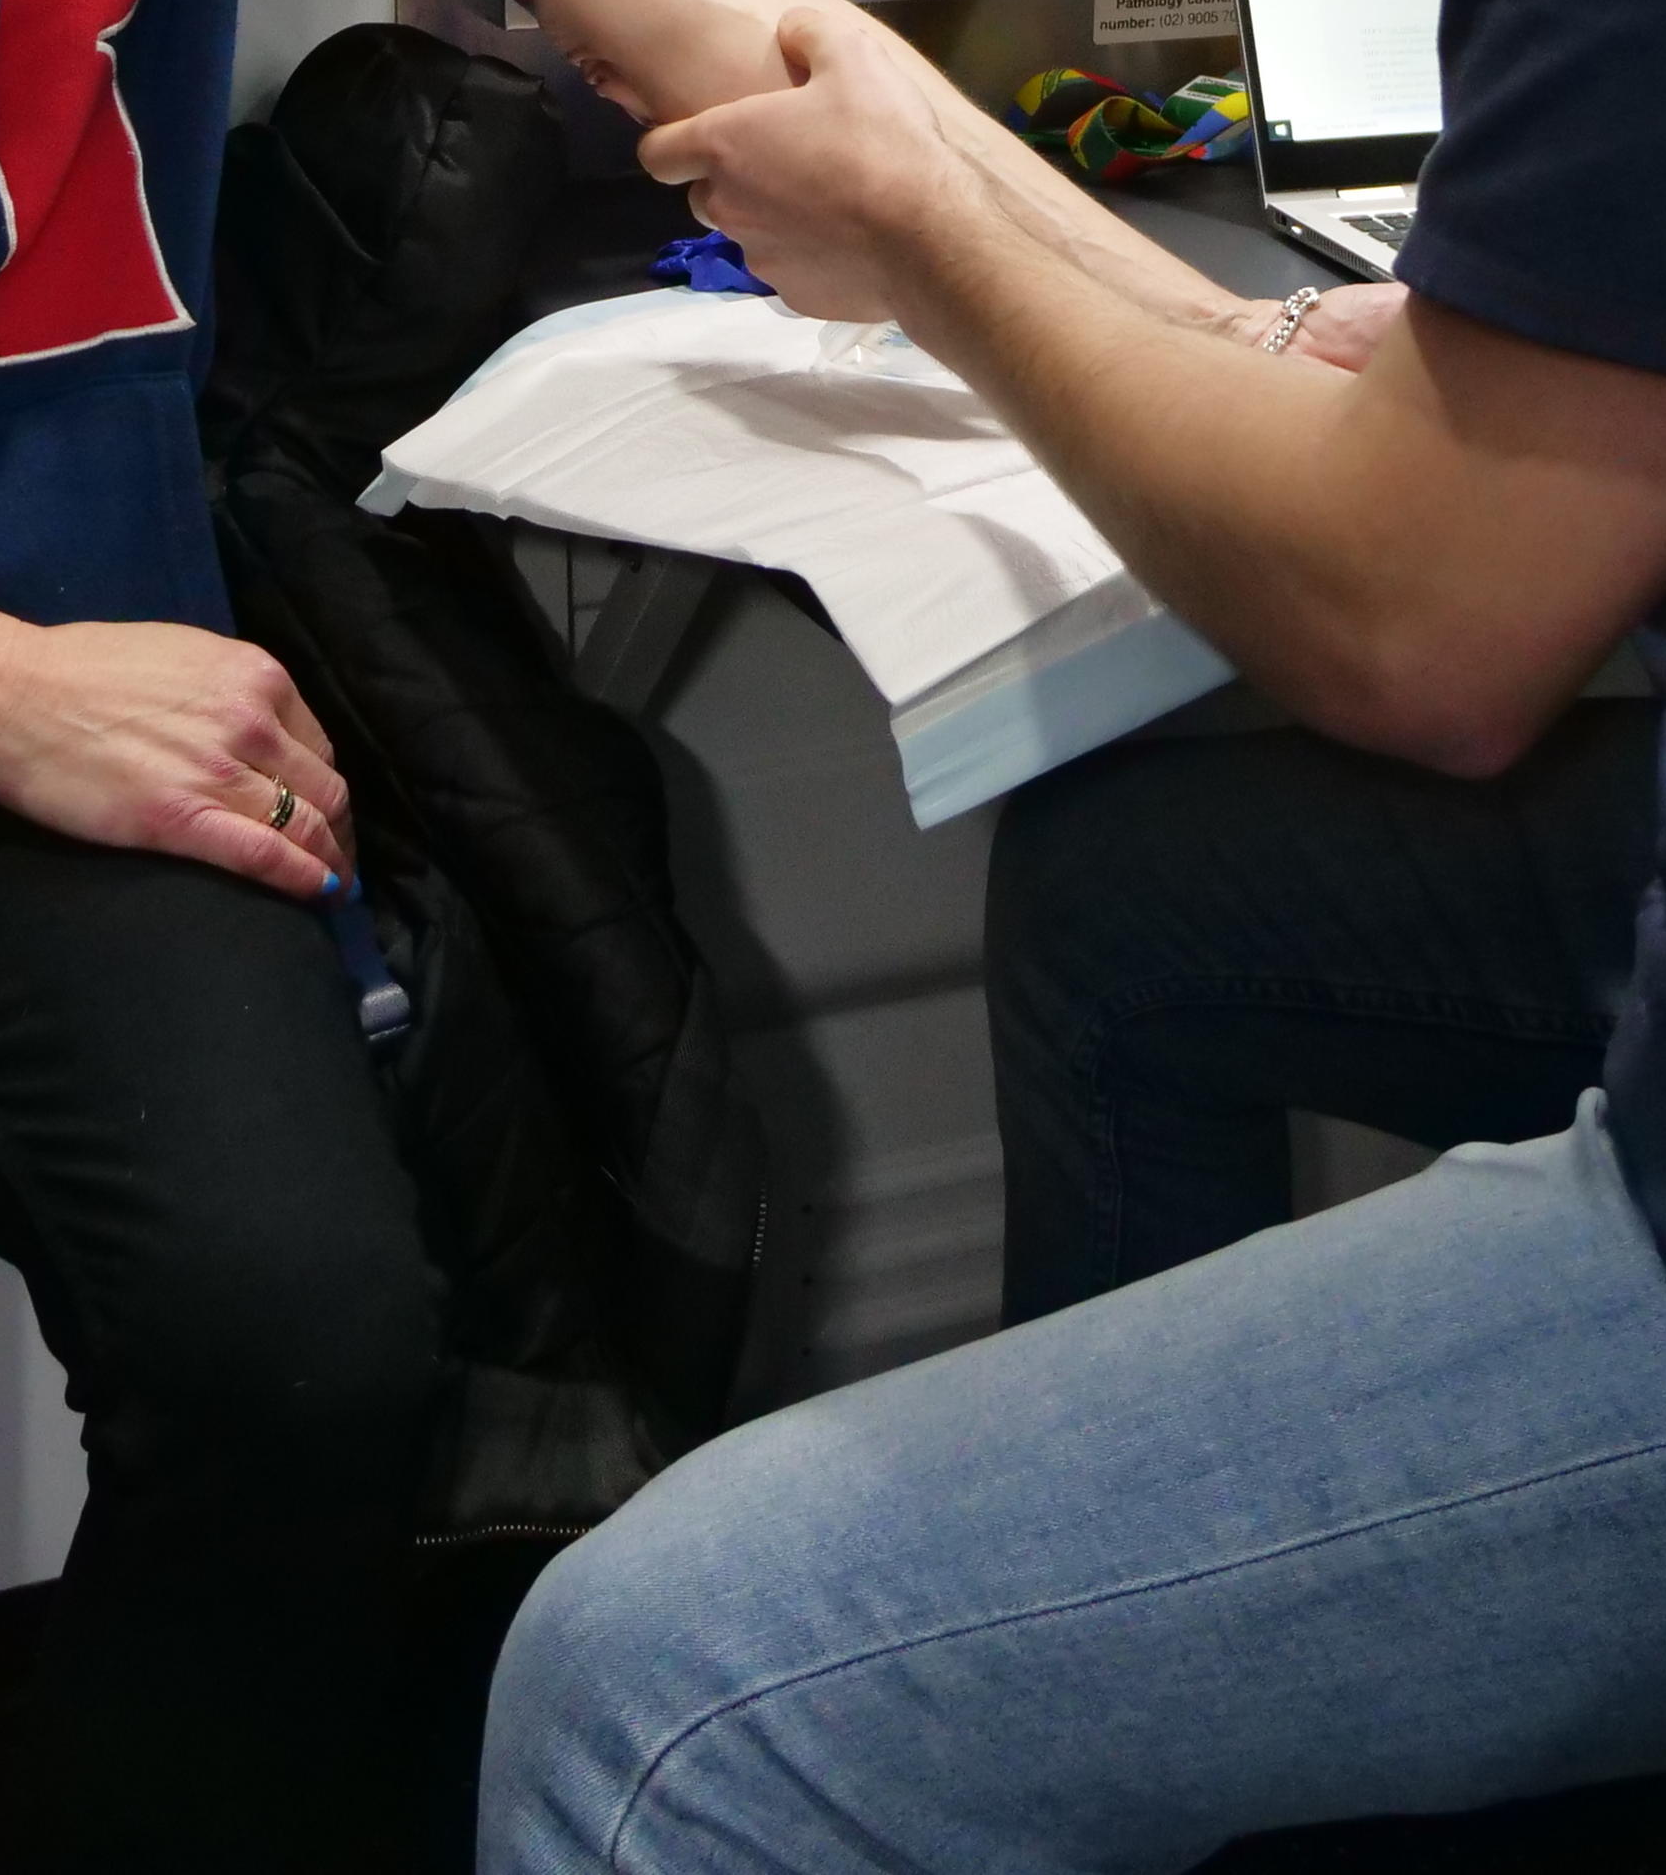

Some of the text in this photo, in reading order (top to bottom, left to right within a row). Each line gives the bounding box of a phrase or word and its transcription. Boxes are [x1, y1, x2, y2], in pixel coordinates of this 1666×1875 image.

[1100, 16, 1156, 31] number:
[1159, 12, 1183, 28] (02)
[1187, 11, 1219, 25] 9005
